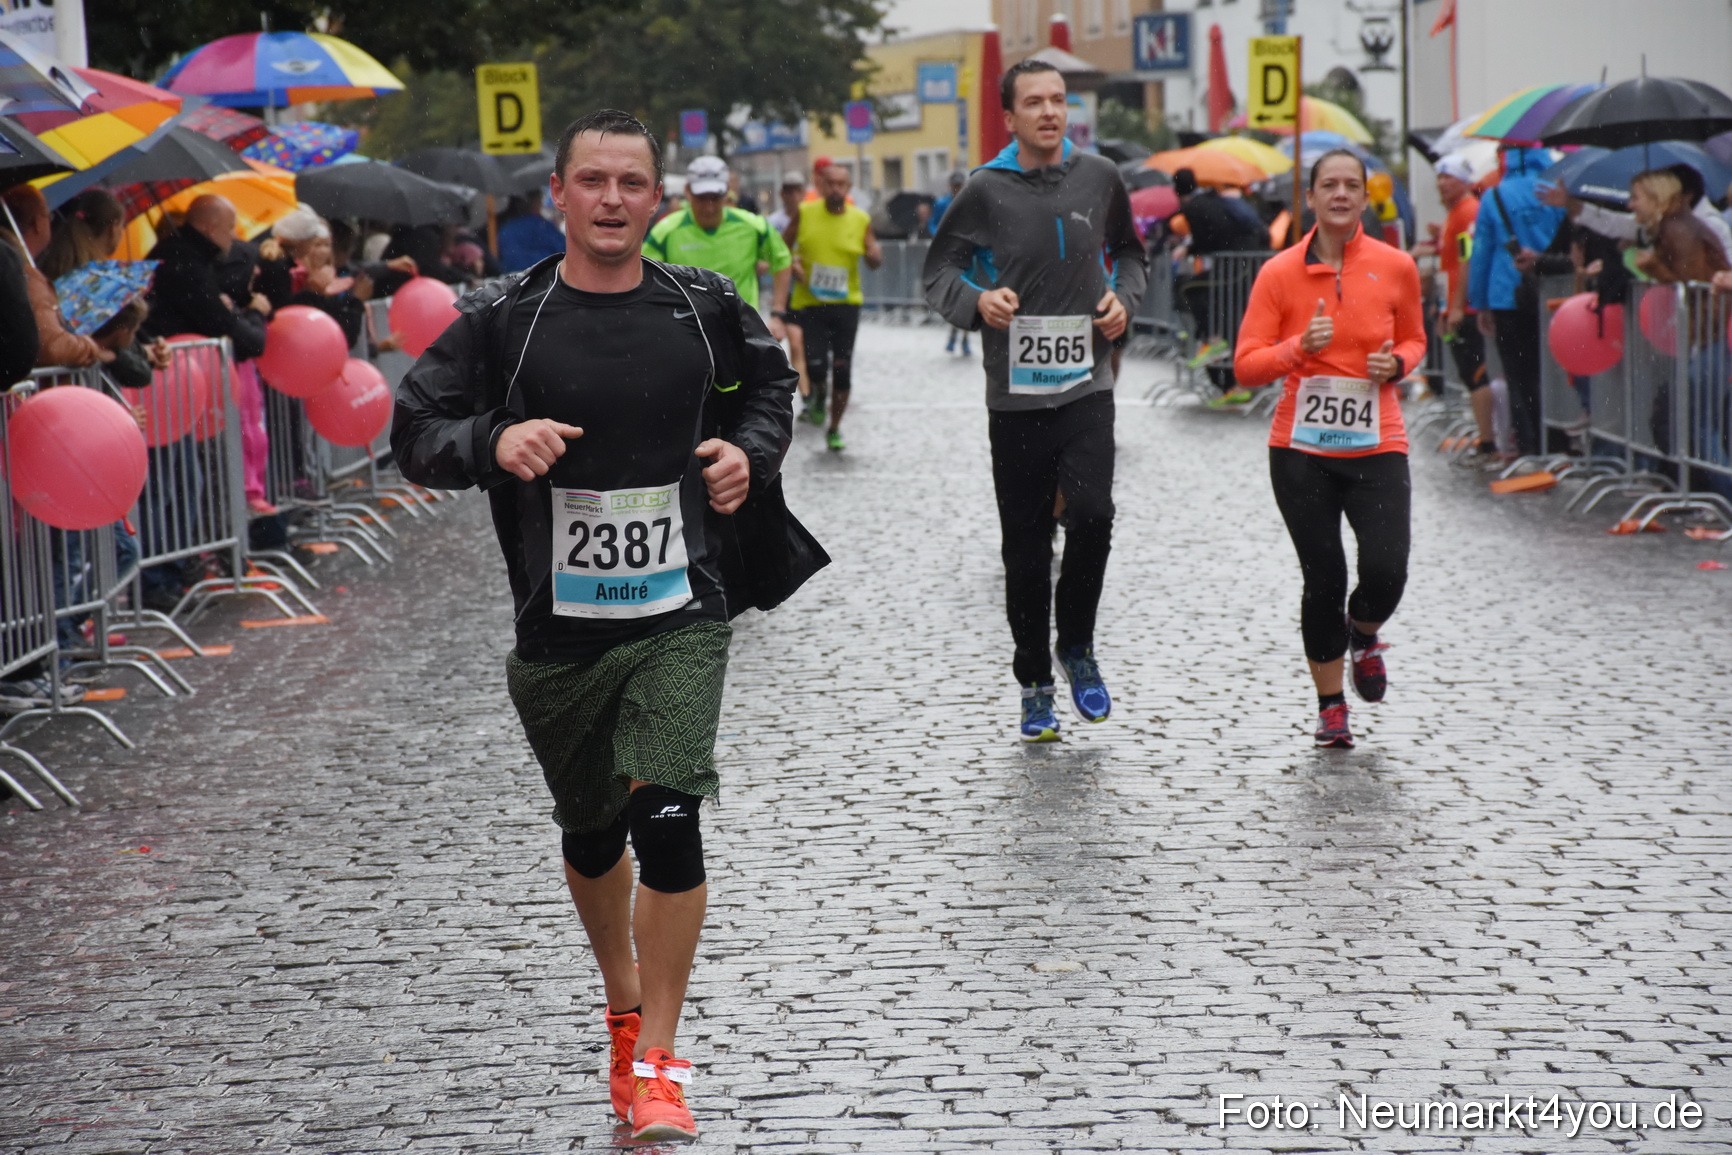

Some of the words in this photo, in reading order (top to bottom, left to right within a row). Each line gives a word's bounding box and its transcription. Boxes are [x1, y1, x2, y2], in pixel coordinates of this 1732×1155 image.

[484, 68, 528, 85] Block
[1263, 64, 1288, 106] D
[495, 92, 524, 134] D
[1019, 335, 1085, 365] 2565
[1304, 394, 1373, 428] 2564
[1319, 431, 1352, 446] Katrin
[564, 502, 603, 514] NeuerMarkt
[611, 489, 672, 510] BOCK
[567, 516, 672, 570] 2387
[557, 561, 564, 571] D
[595, 580, 648, 601] André
